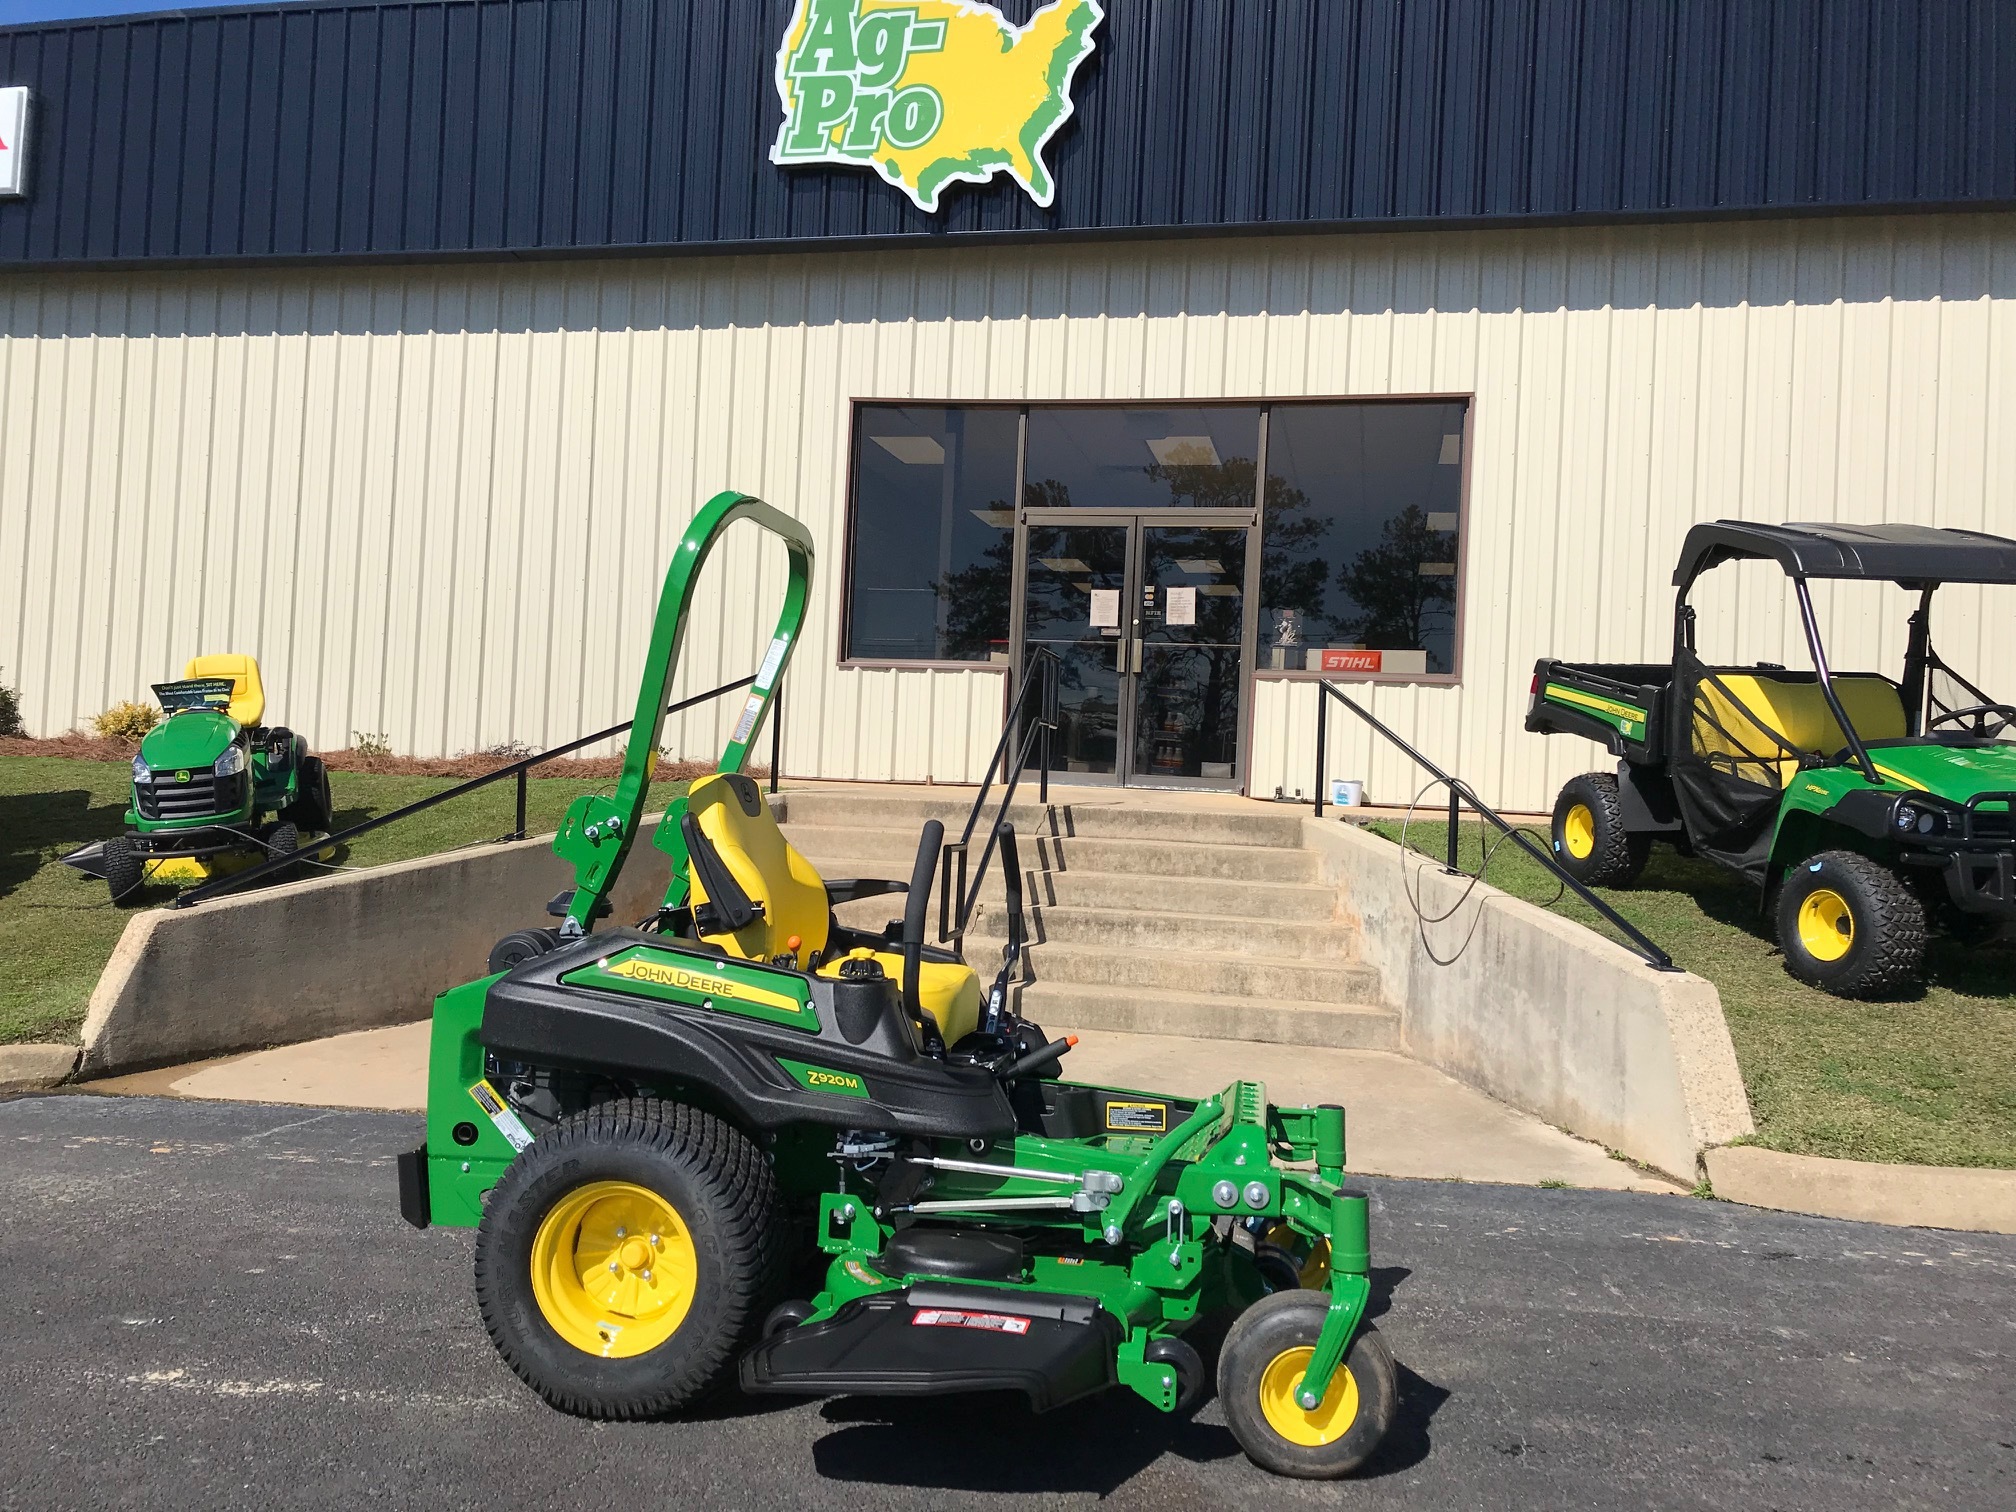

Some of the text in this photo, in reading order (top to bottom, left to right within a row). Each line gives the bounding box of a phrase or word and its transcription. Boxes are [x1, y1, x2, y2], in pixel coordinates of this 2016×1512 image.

[786, 0, 948, 90] Ag-
[783, 75, 943, 156] Pro
[1325, 656, 1375, 669] STIHL
[1604, 703, 1639, 720] JOHN DEERE
[625, 962, 734, 996] JOHN DEERE
[806, 1070, 858, 1089] Z920M
